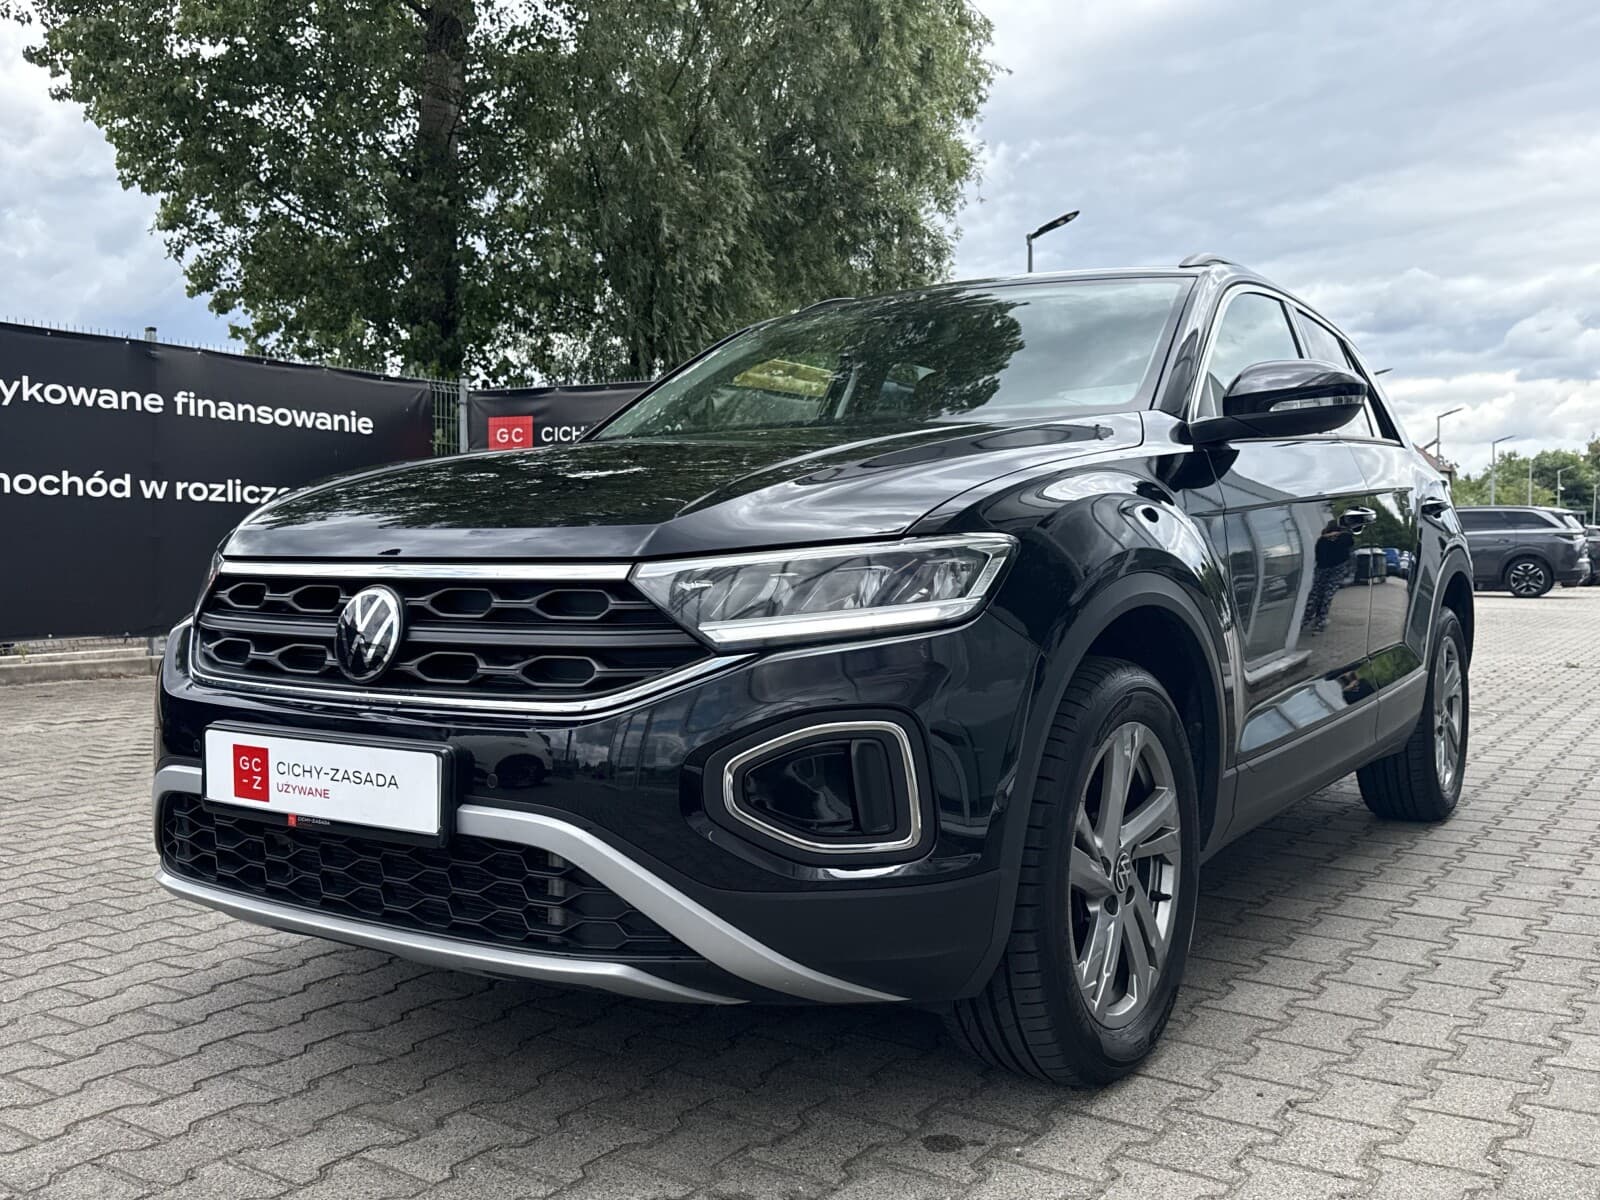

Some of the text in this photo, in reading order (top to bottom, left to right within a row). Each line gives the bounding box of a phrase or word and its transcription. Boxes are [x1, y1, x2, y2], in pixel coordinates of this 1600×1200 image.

[0, 375, 374, 434] ykowane finansowanie
[496, 427, 524, 443] GC
[540, 425, 588, 442] CICH
[139, 478, 168, 499] w
[239, 756, 262, 772] GC
[276, 761, 399, 789] CICHY-ZASADA
